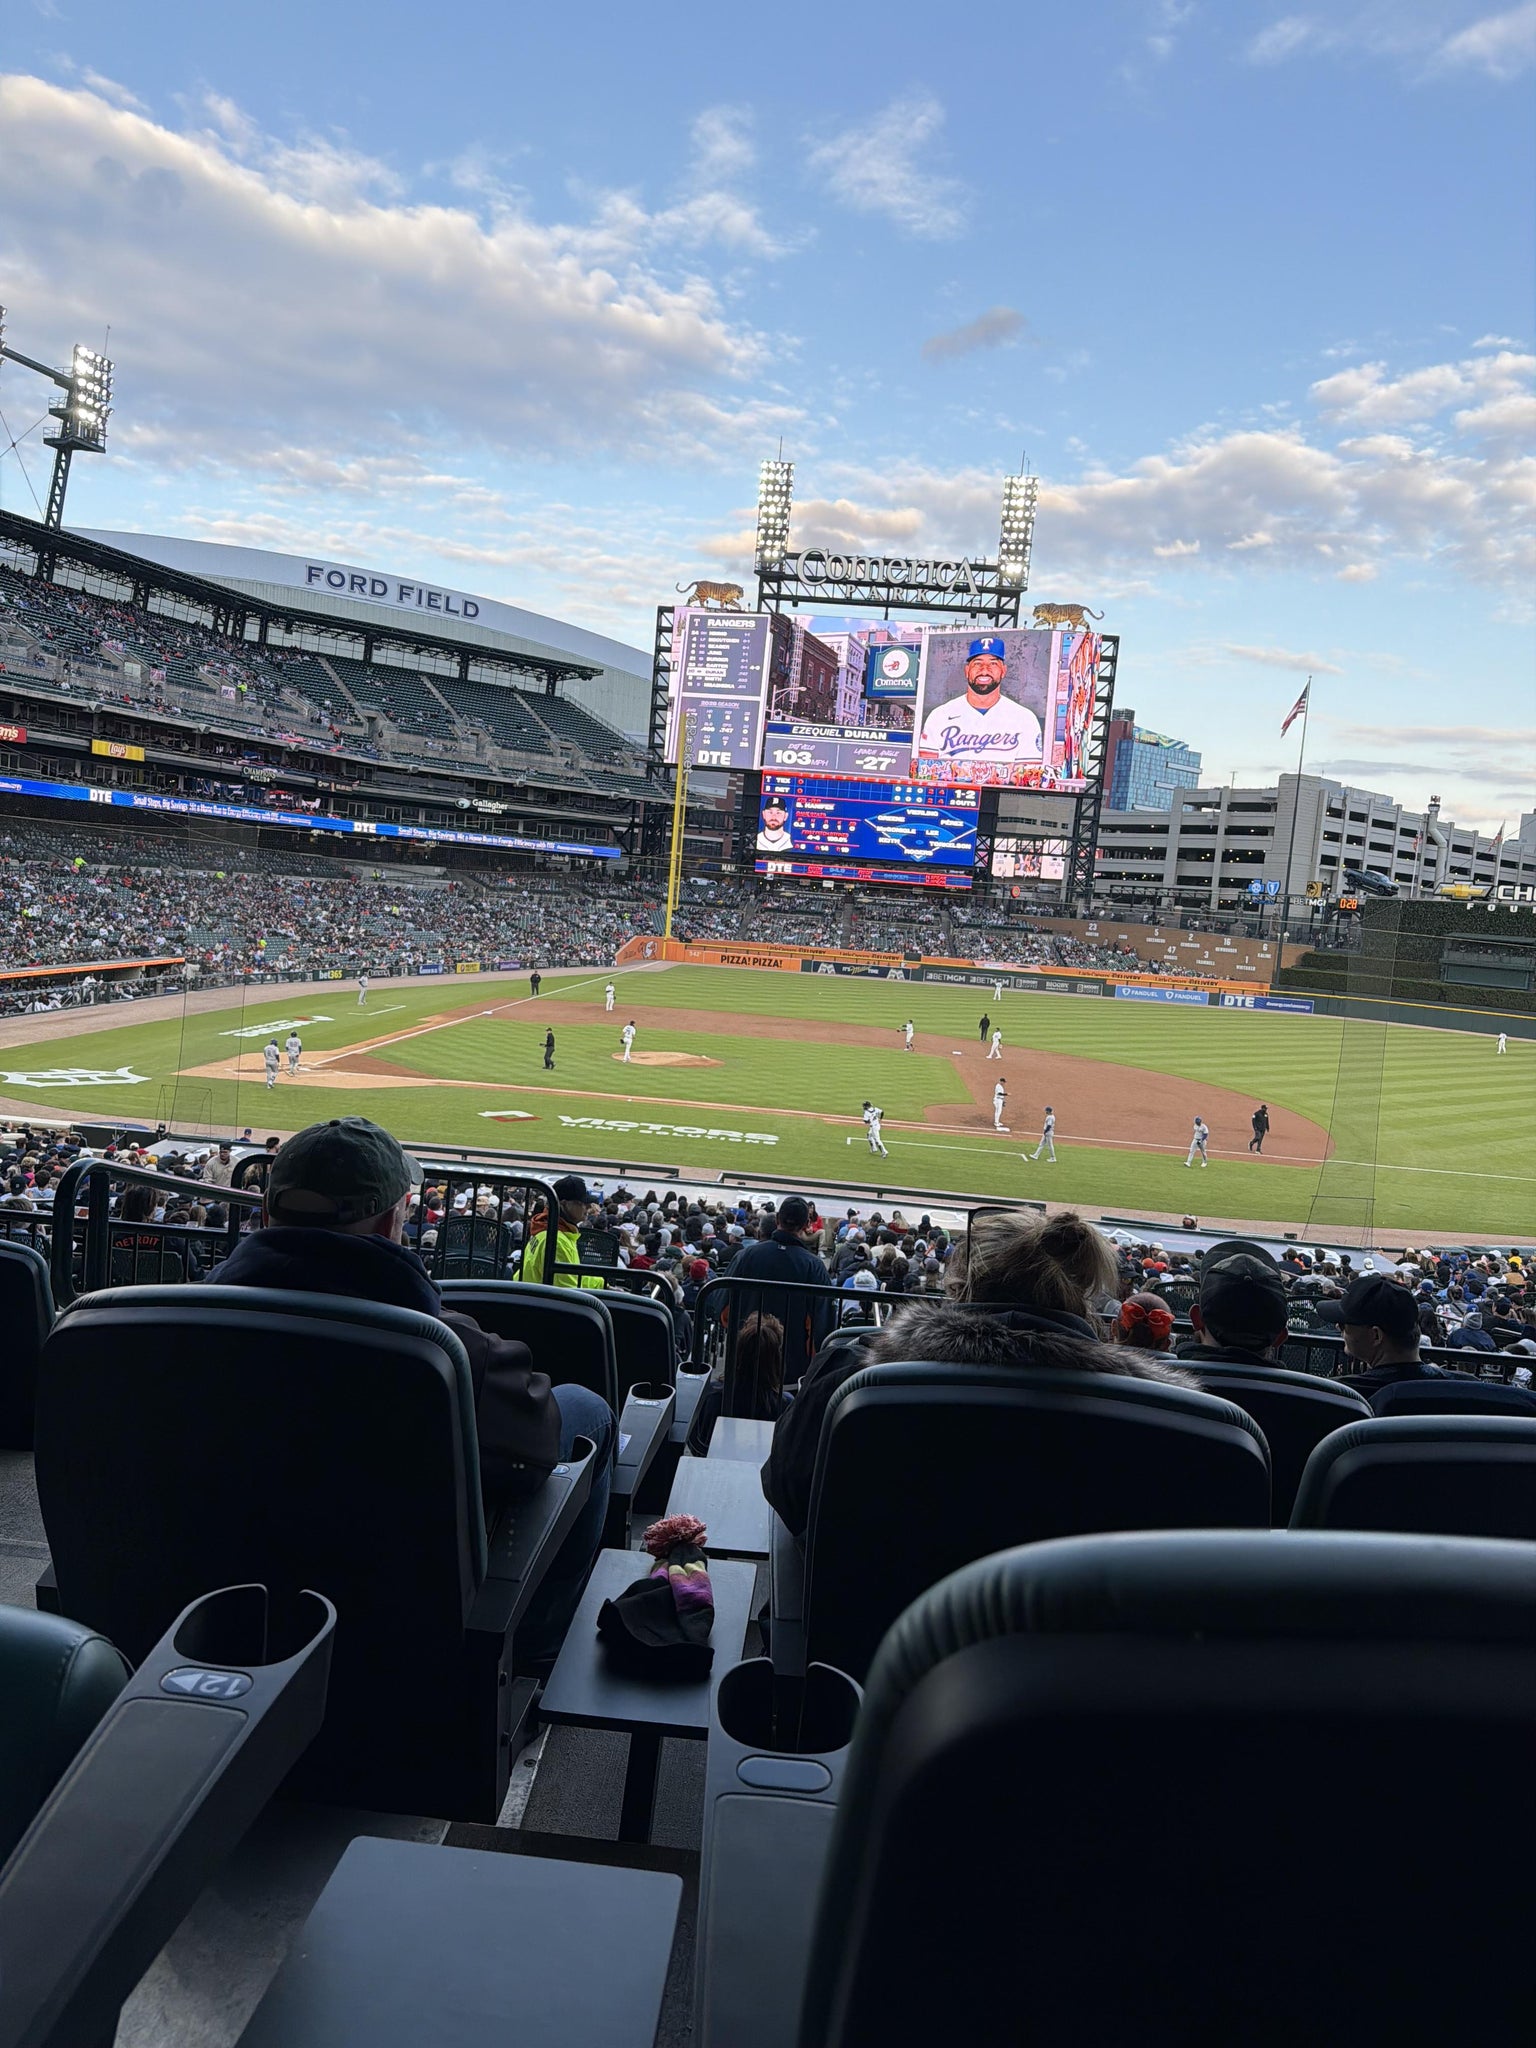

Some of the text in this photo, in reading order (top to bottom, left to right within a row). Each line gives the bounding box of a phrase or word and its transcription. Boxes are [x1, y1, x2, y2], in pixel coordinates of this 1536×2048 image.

[305, 564, 480, 620] FORD FIELD
[846, 585, 930, 603] PARK
[707, 619, 756, 628] RANGERS
[981, 637, 993, 650] T
[792, 726, 887, 740] EZEQUIEL DURAN
[940, 725, 1021, 752] Rangers
[698, 750, 731, 766] DTE
[773, 750, 812, 766] 103
[243, 766, 276, 779] CHAMPIONS
[90, 790, 112, 803] DTE
[954, 790, 976, 800] 1-2
[472, 799, 508, 810] Gallagher
[354, 822, 376, 834] DTE
[767, 861, 792, 873] DTE
[1498, 885, 1536, 901] CH
[1340, 898, 1358, 910] 0:28
[1154, 928, 1159, 936] 5
[1224, 938, 1232, 946] 16
[1168, 946, 1176, 954] 47
[720, 954, 783, 968] PIZZA! PIZZA!
[319, 970, 342, 980] bet365
[932, 973, 966, 982] BETMGM
[1131, 990, 1159, 998] FANDUEL
[1224, 996, 1256, 1008] DTE
[558, 1115, 780, 1142] VICTORS
[562, 1122, 777, 1146] HOME SOLUTIONS
[114, 1236, 160, 1248] DETROIT
[199, 1674, 242, 1697] 12
